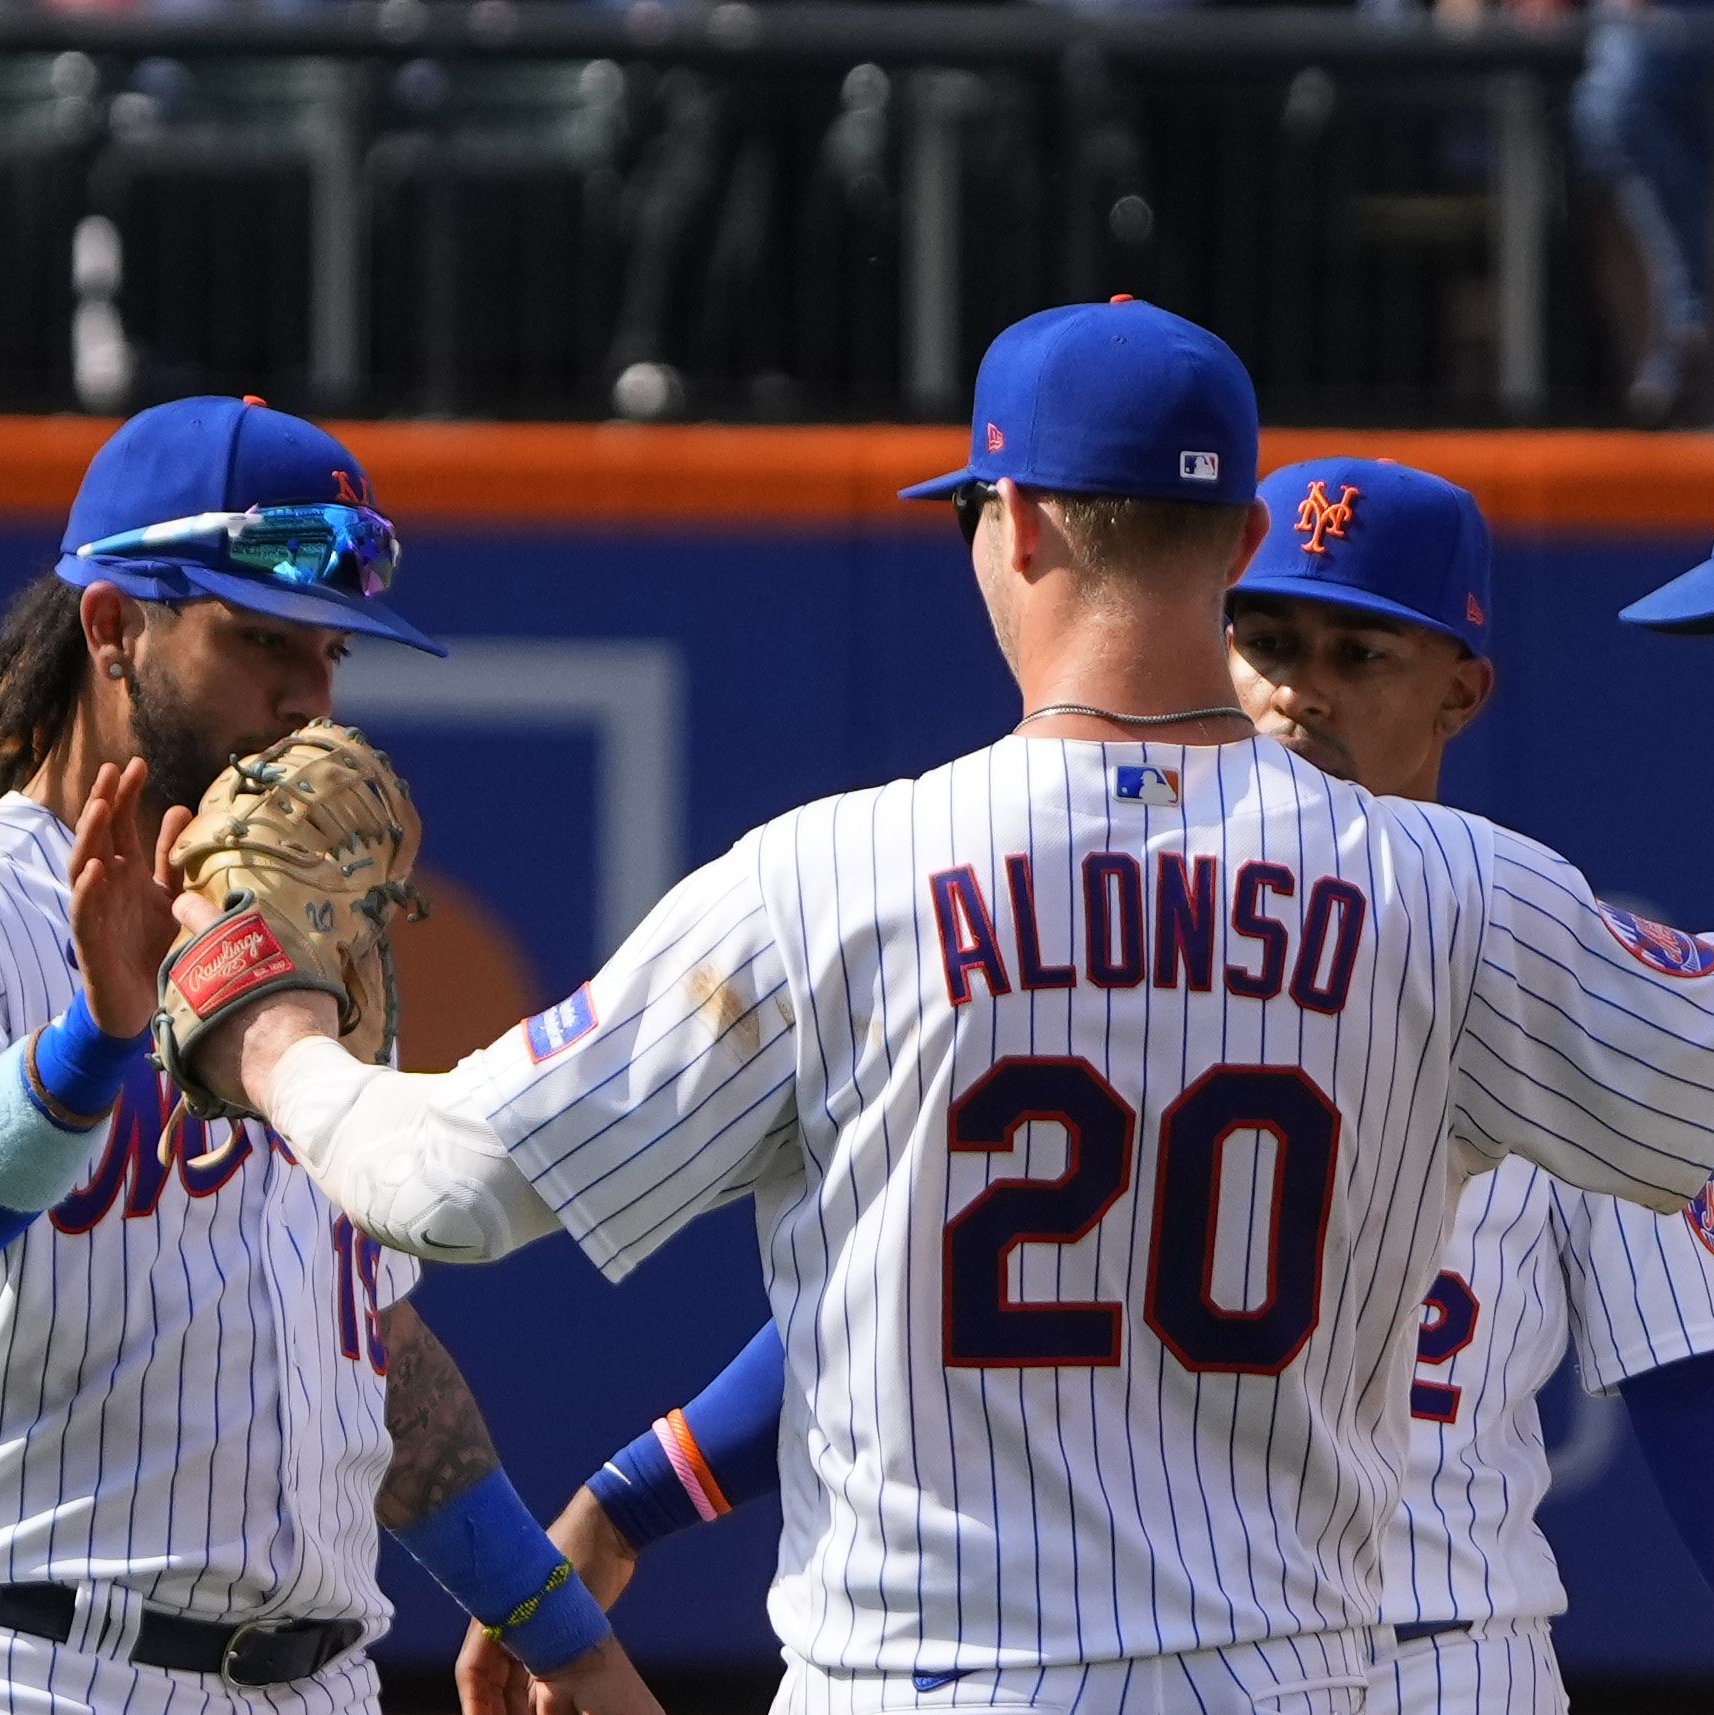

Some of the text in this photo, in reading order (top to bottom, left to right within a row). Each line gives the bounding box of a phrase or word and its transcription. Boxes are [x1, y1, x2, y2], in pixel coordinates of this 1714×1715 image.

[188, 931, 264, 992] Rawlings
[929, 851, 1368, 1015] ALONSO
[942, 1055, 1343, 1376] 20
